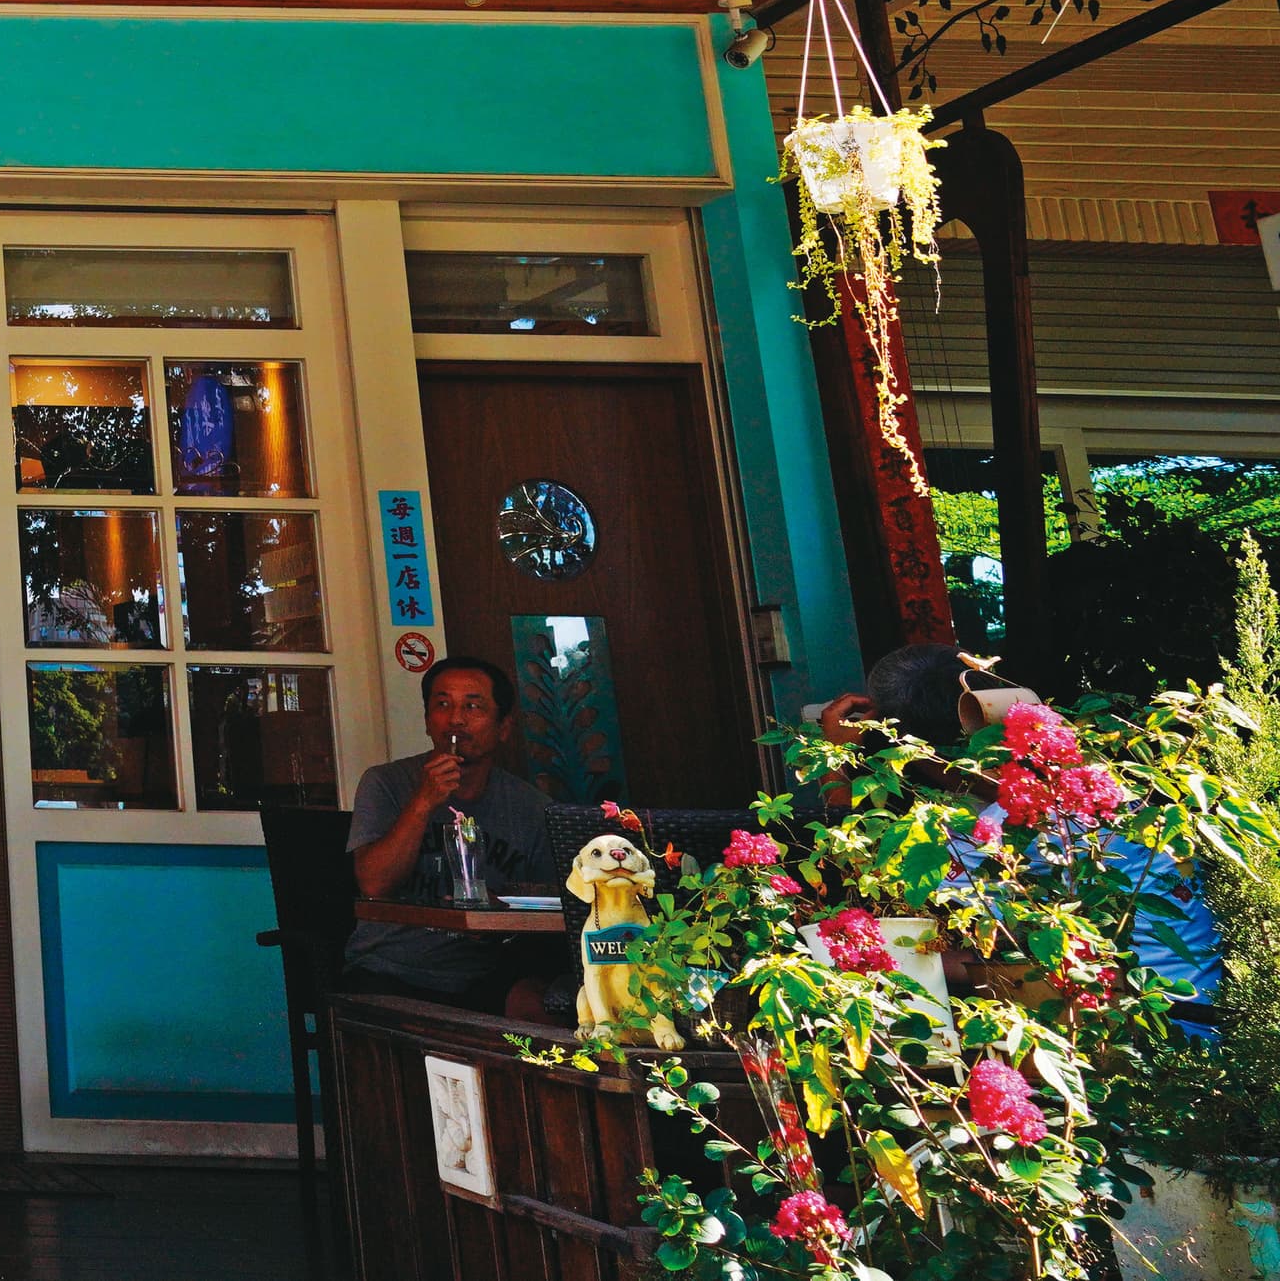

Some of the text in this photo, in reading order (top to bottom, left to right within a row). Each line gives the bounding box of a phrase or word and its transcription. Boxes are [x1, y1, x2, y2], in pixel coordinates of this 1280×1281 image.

[386, 496, 427, 620] 每週一店休
